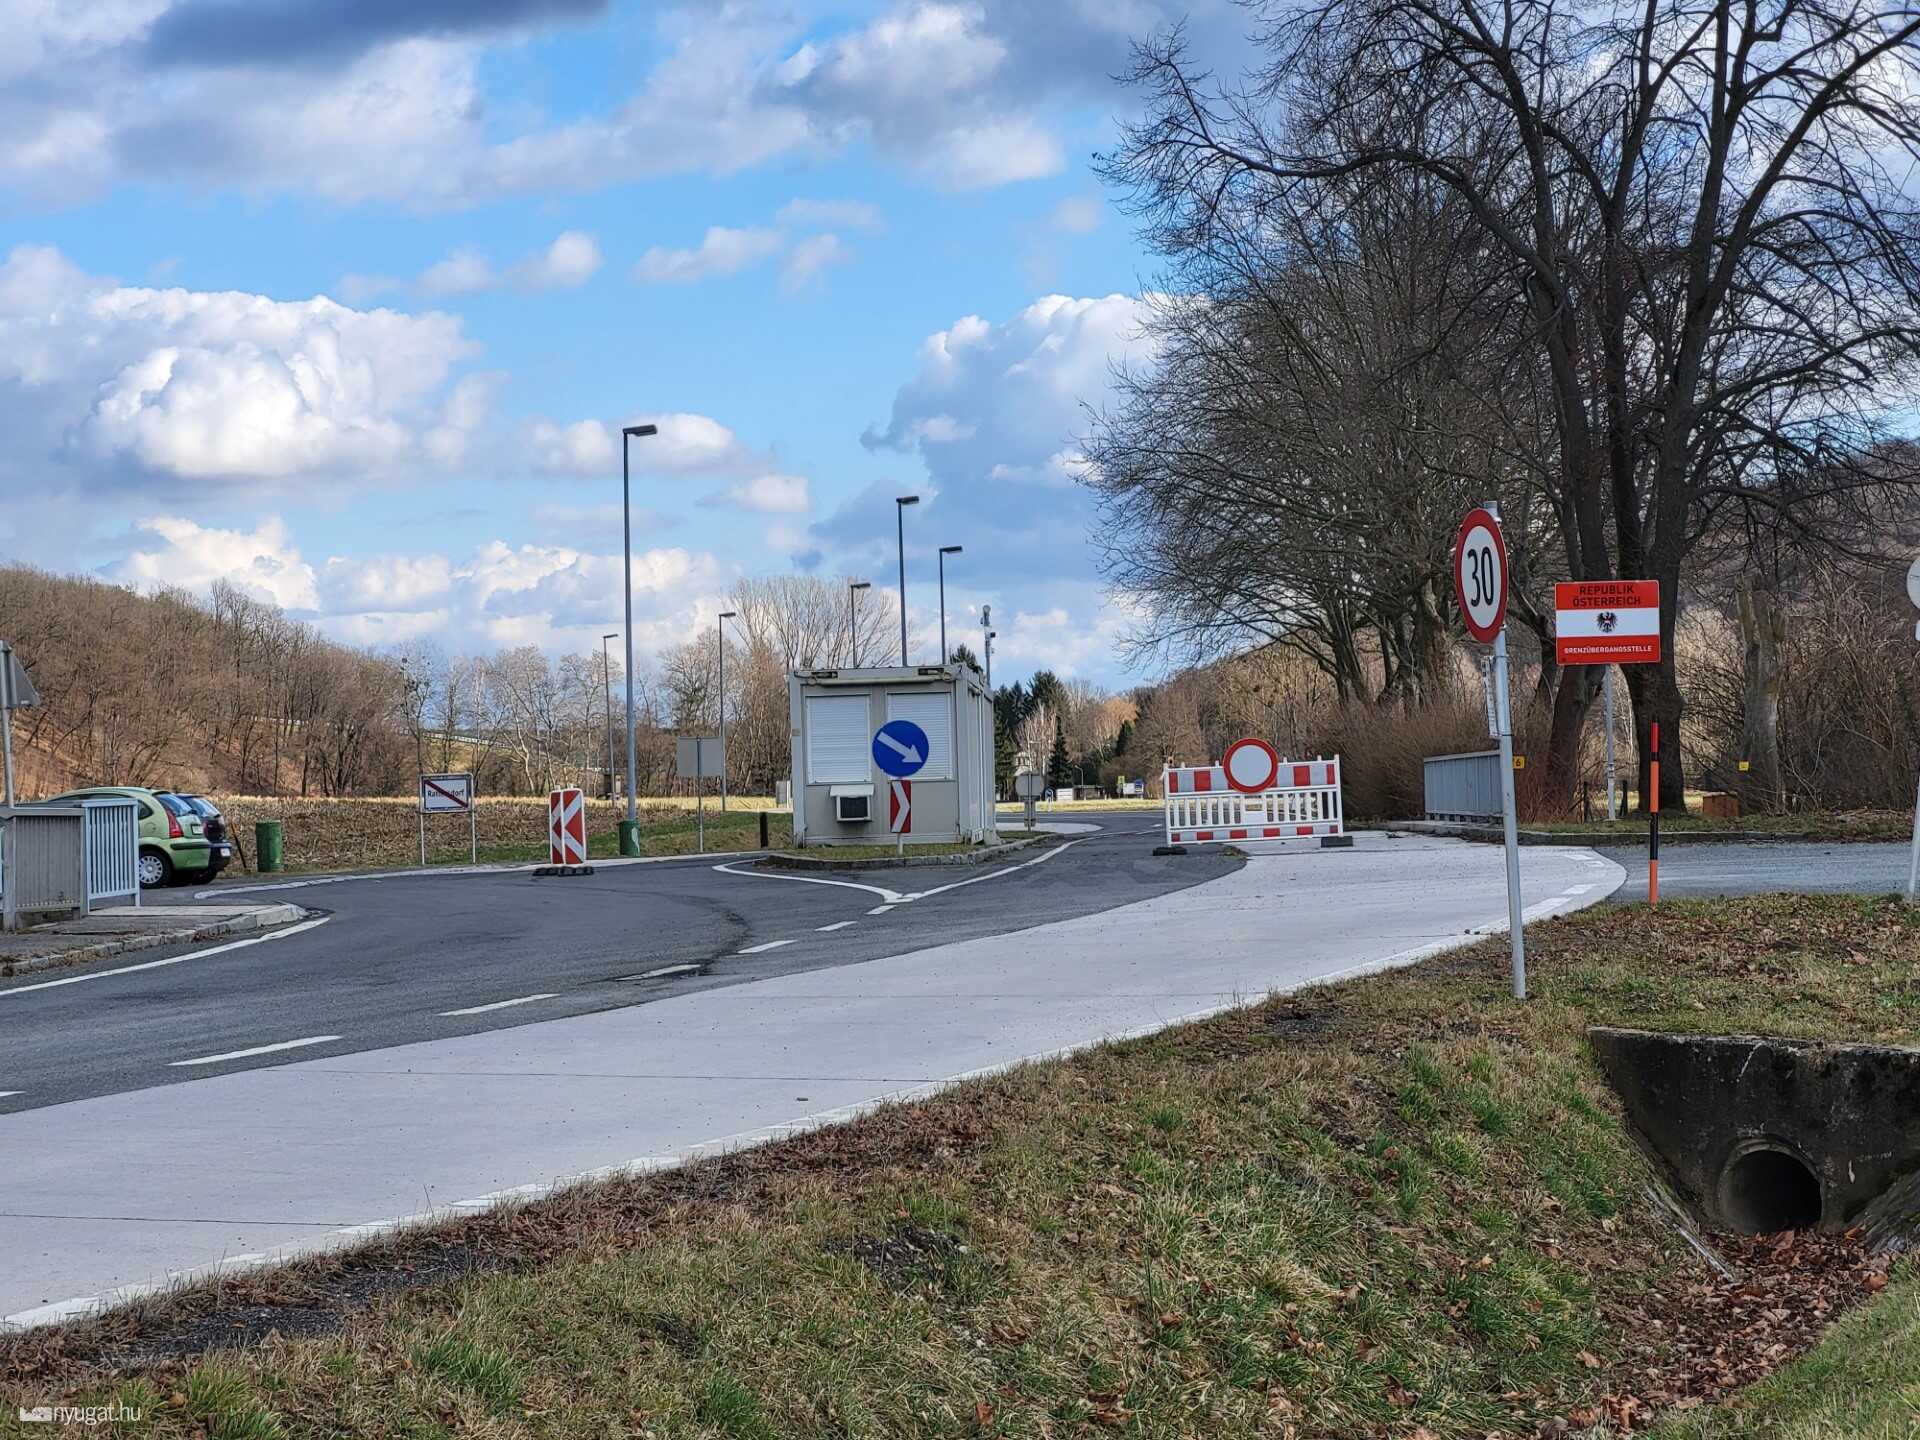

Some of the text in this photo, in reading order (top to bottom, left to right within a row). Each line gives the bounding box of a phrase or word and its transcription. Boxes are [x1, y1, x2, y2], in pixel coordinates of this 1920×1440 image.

[1467, 546, 1495, 608] 30
[1579, 585, 1635, 595] REPUBLIK
[1572, 595, 1641, 607] ÖSTERREICH
[1564, 645, 1653, 655] GRENZÜBERGANGSSTELLE
